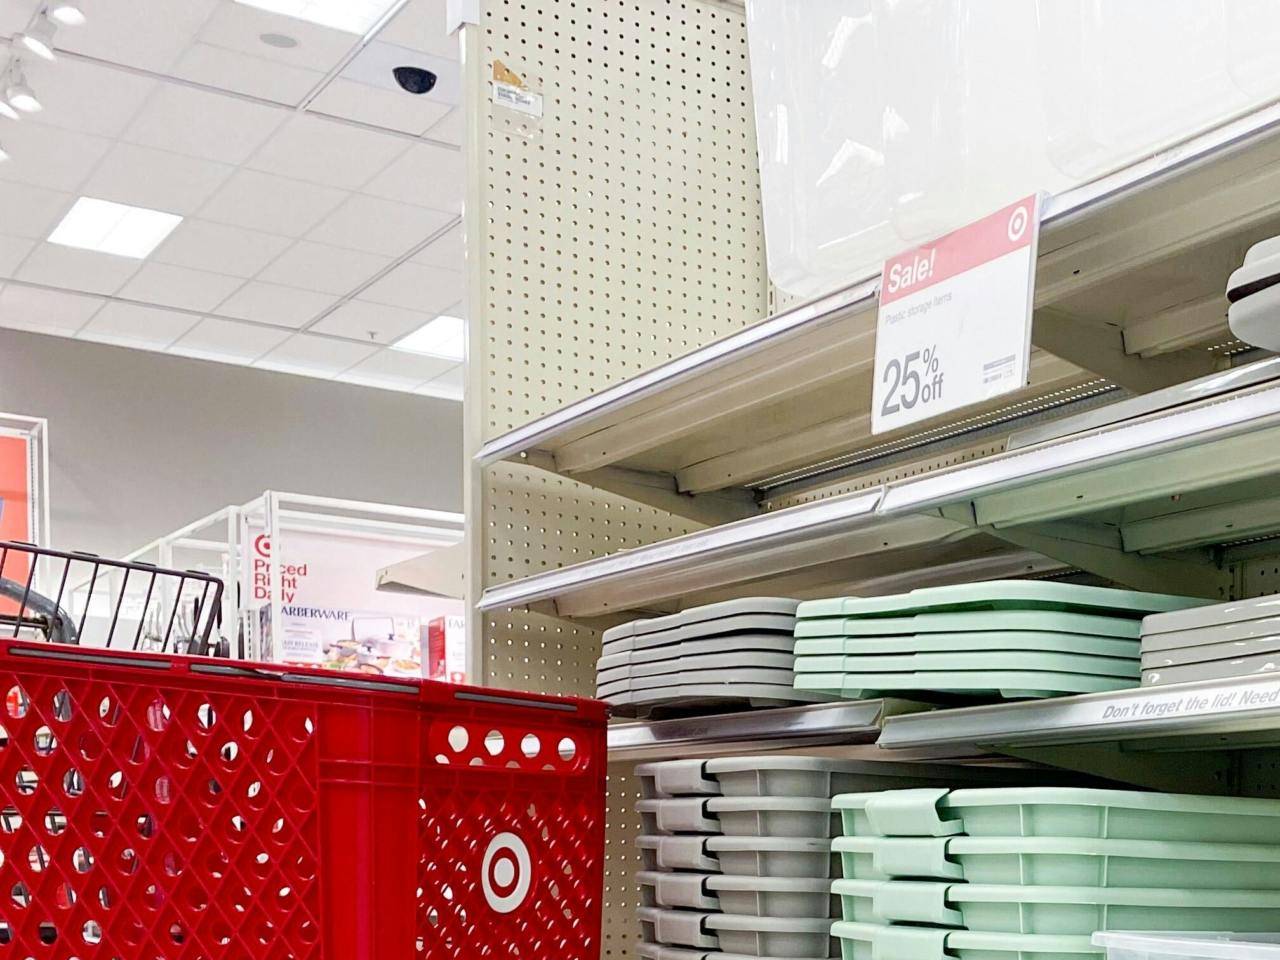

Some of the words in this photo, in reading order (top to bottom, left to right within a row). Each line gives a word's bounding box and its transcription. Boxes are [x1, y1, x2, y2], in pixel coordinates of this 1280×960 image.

[888, 248, 936, 293] Sale!
[921, 372, 944, 403] off
[254, 559, 307, 576] Prced
[254, 573, 297, 588] Riht
[254, 586, 295, 603] Daly
[281, 606, 350, 621] ARBERWARE
[1102, 702, 1140, 719] Don't
[1140, 698, 1184, 717] forget
[1185, 696, 1209, 711] the
[1210, 691, 1238, 708] lid!
